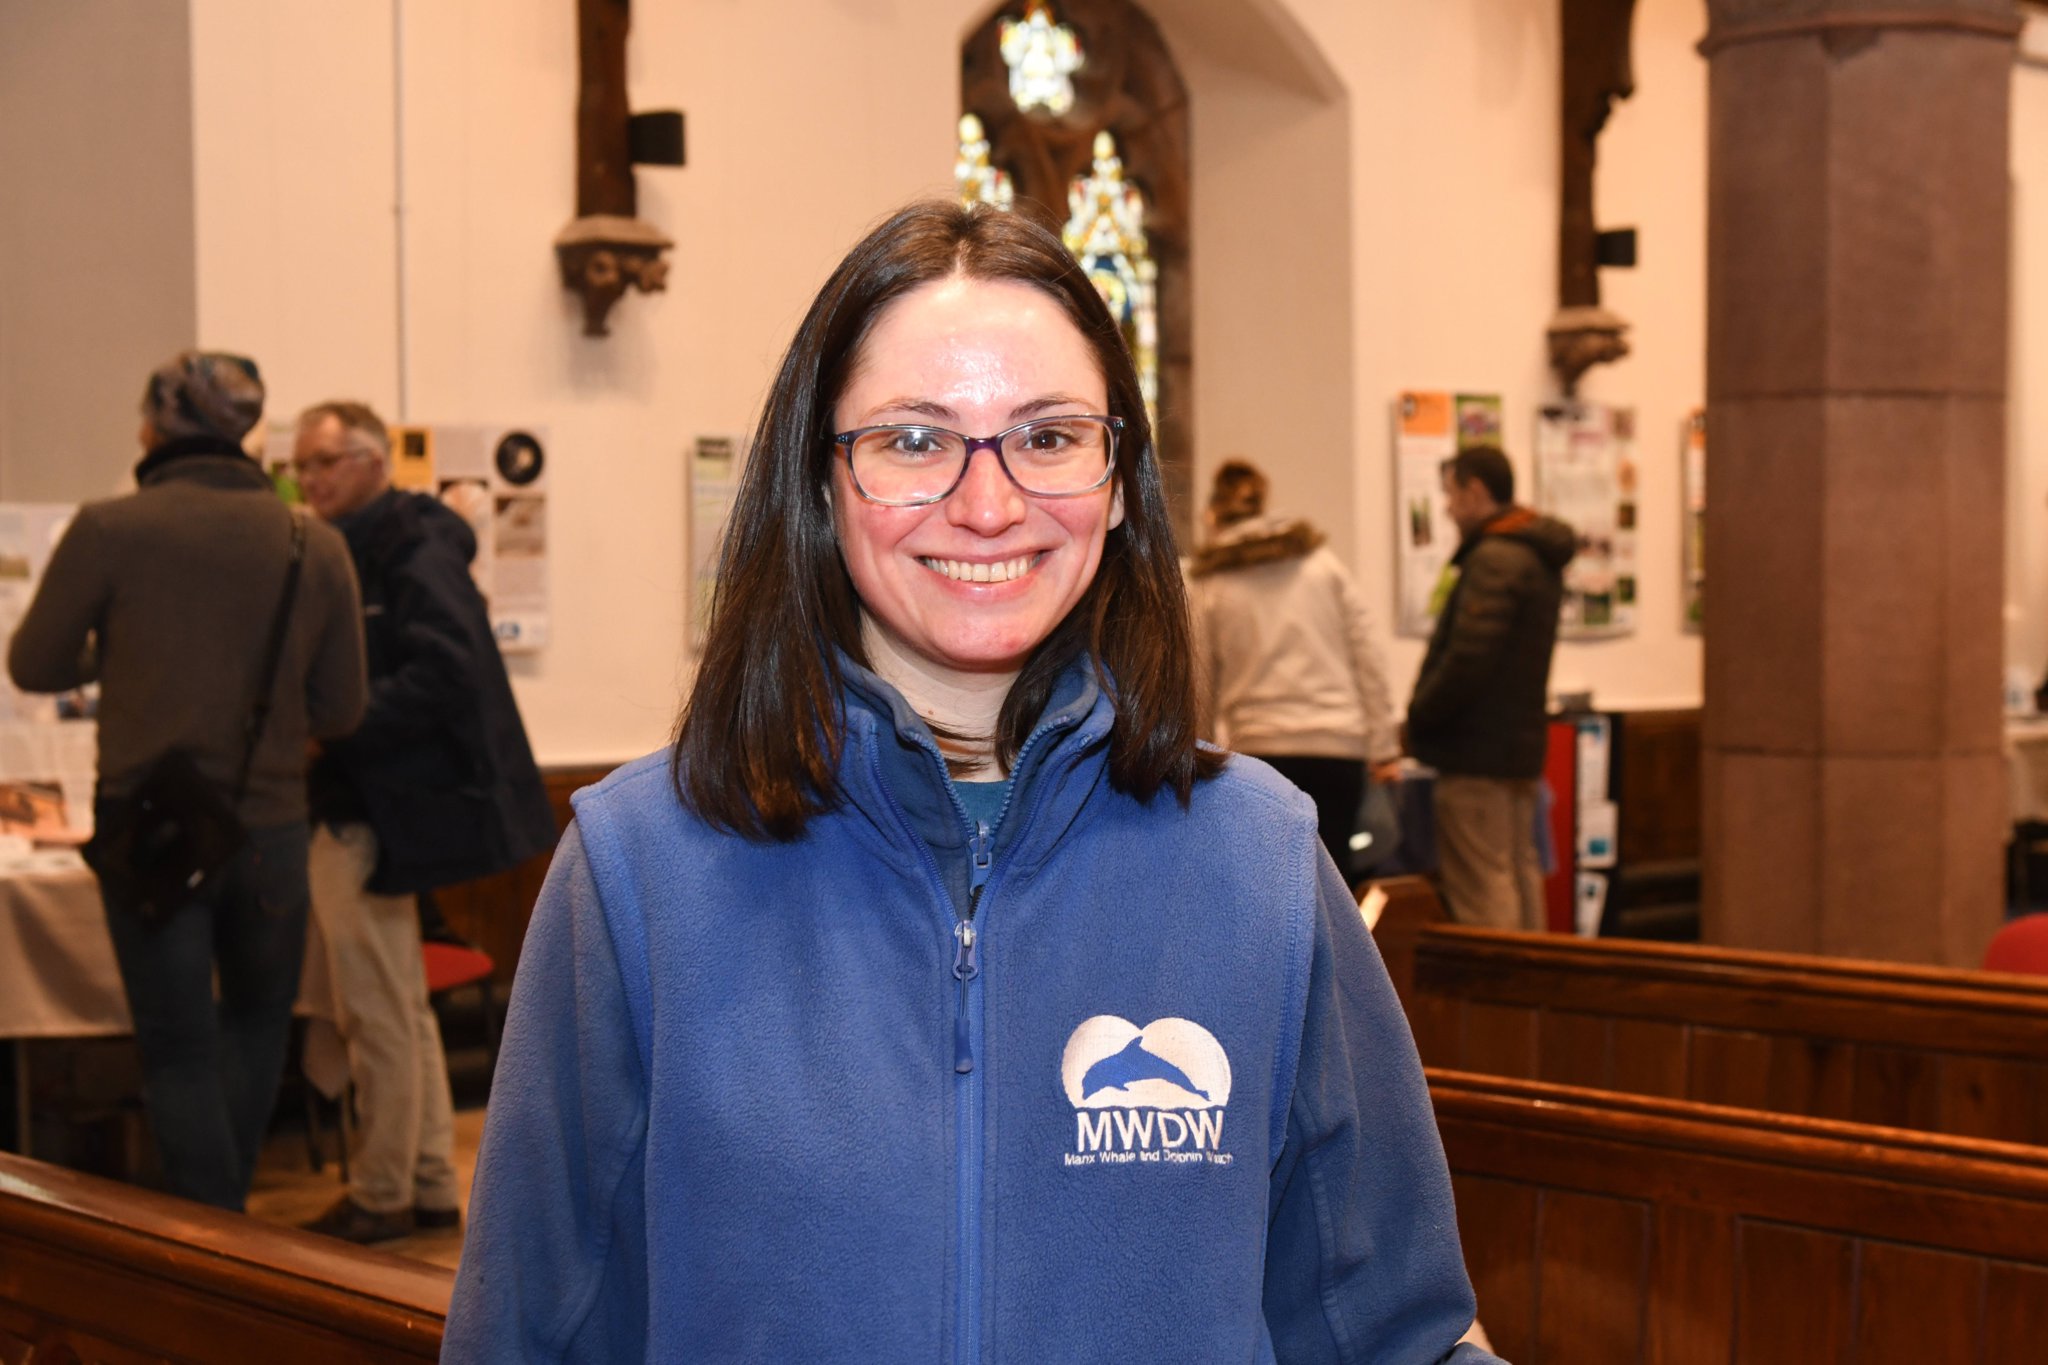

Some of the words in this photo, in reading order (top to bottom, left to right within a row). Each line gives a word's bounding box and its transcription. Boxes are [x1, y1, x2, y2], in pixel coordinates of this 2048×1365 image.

[1077, 1110, 1223, 1151] MWDW
[1065, 1152, 1096, 1166] Manx
[1099, 1151, 1136, 1163] Whale
